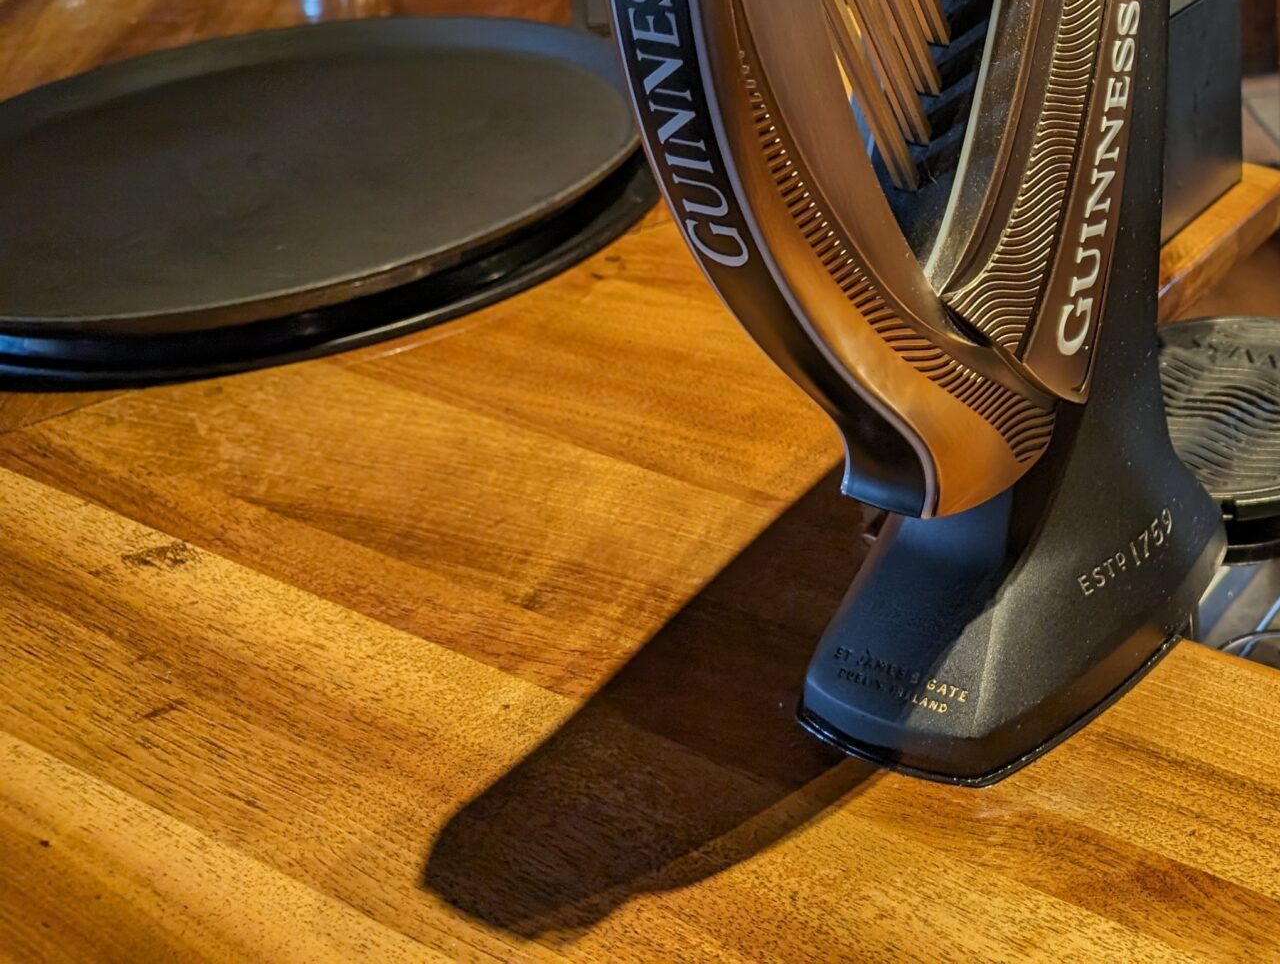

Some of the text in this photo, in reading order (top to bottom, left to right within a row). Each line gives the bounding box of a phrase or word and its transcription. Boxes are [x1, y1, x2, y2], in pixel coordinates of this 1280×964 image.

[1056, 0, 1141, 356] GUINNESS
[1129, 507, 1172, 567] 1759
[926, 678, 969, 703] GATE
